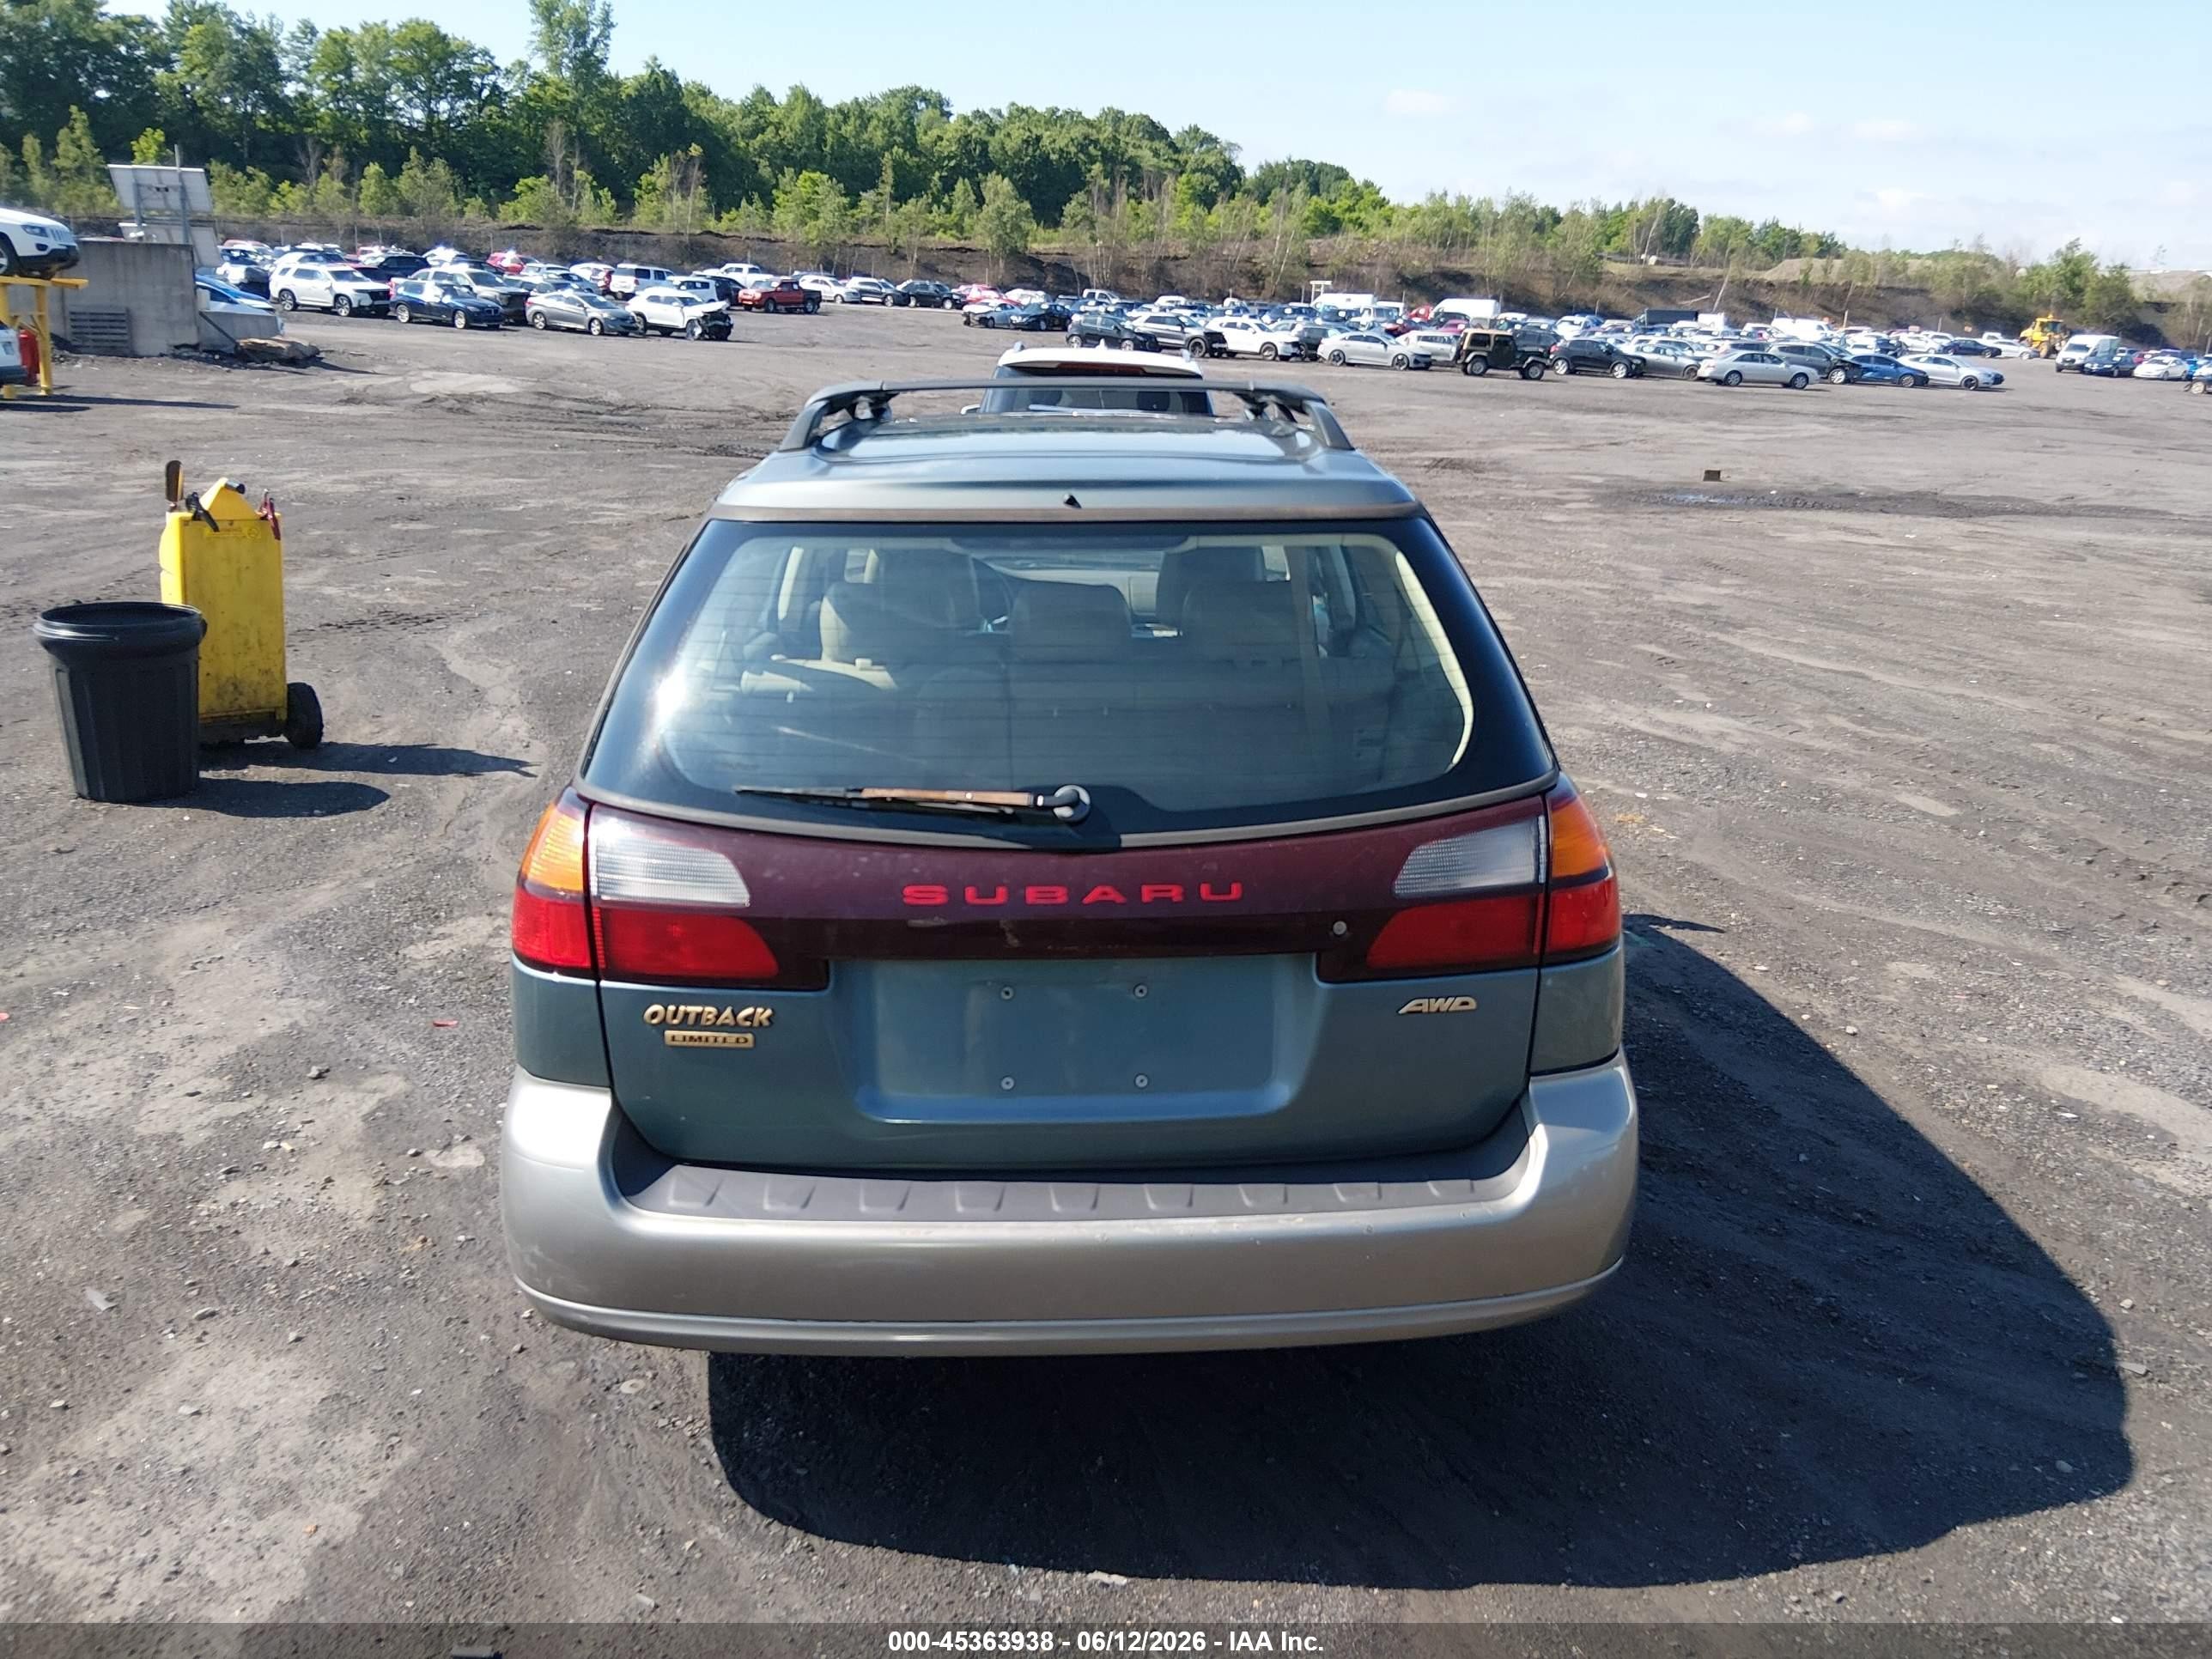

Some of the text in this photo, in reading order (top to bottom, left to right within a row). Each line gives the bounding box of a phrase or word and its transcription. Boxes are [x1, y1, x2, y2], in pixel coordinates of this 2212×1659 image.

[902, 882, 1243, 905] SUBARU
[1398, 996, 1477, 1014] AWD
[644, 1004, 773, 1027] OUTBACK
[670, 1034, 749, 1044] LIMITED
